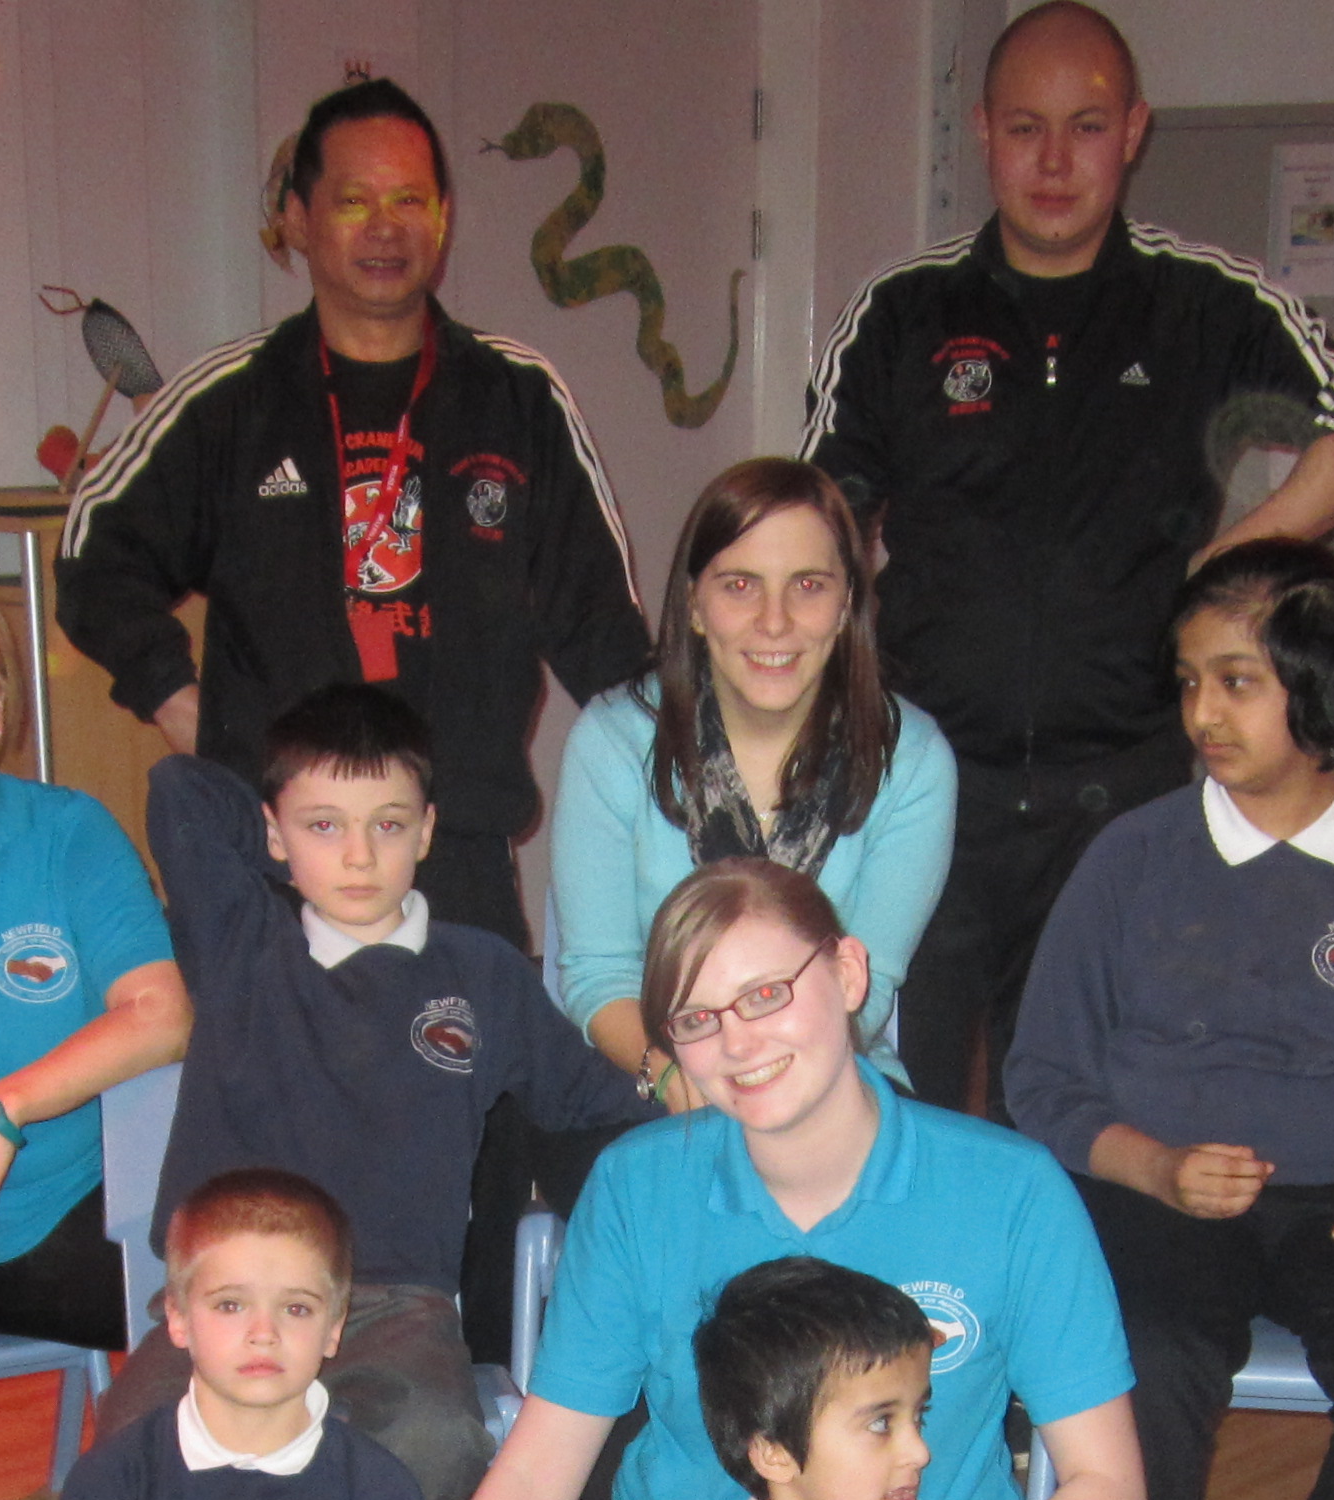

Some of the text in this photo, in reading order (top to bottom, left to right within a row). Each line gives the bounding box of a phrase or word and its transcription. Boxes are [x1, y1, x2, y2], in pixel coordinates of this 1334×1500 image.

[258, 481, 307, 497] adidas
[0, 923, 62, 942] NEWFIELD
[897, 1280, 965, 1299] EWFIELD
